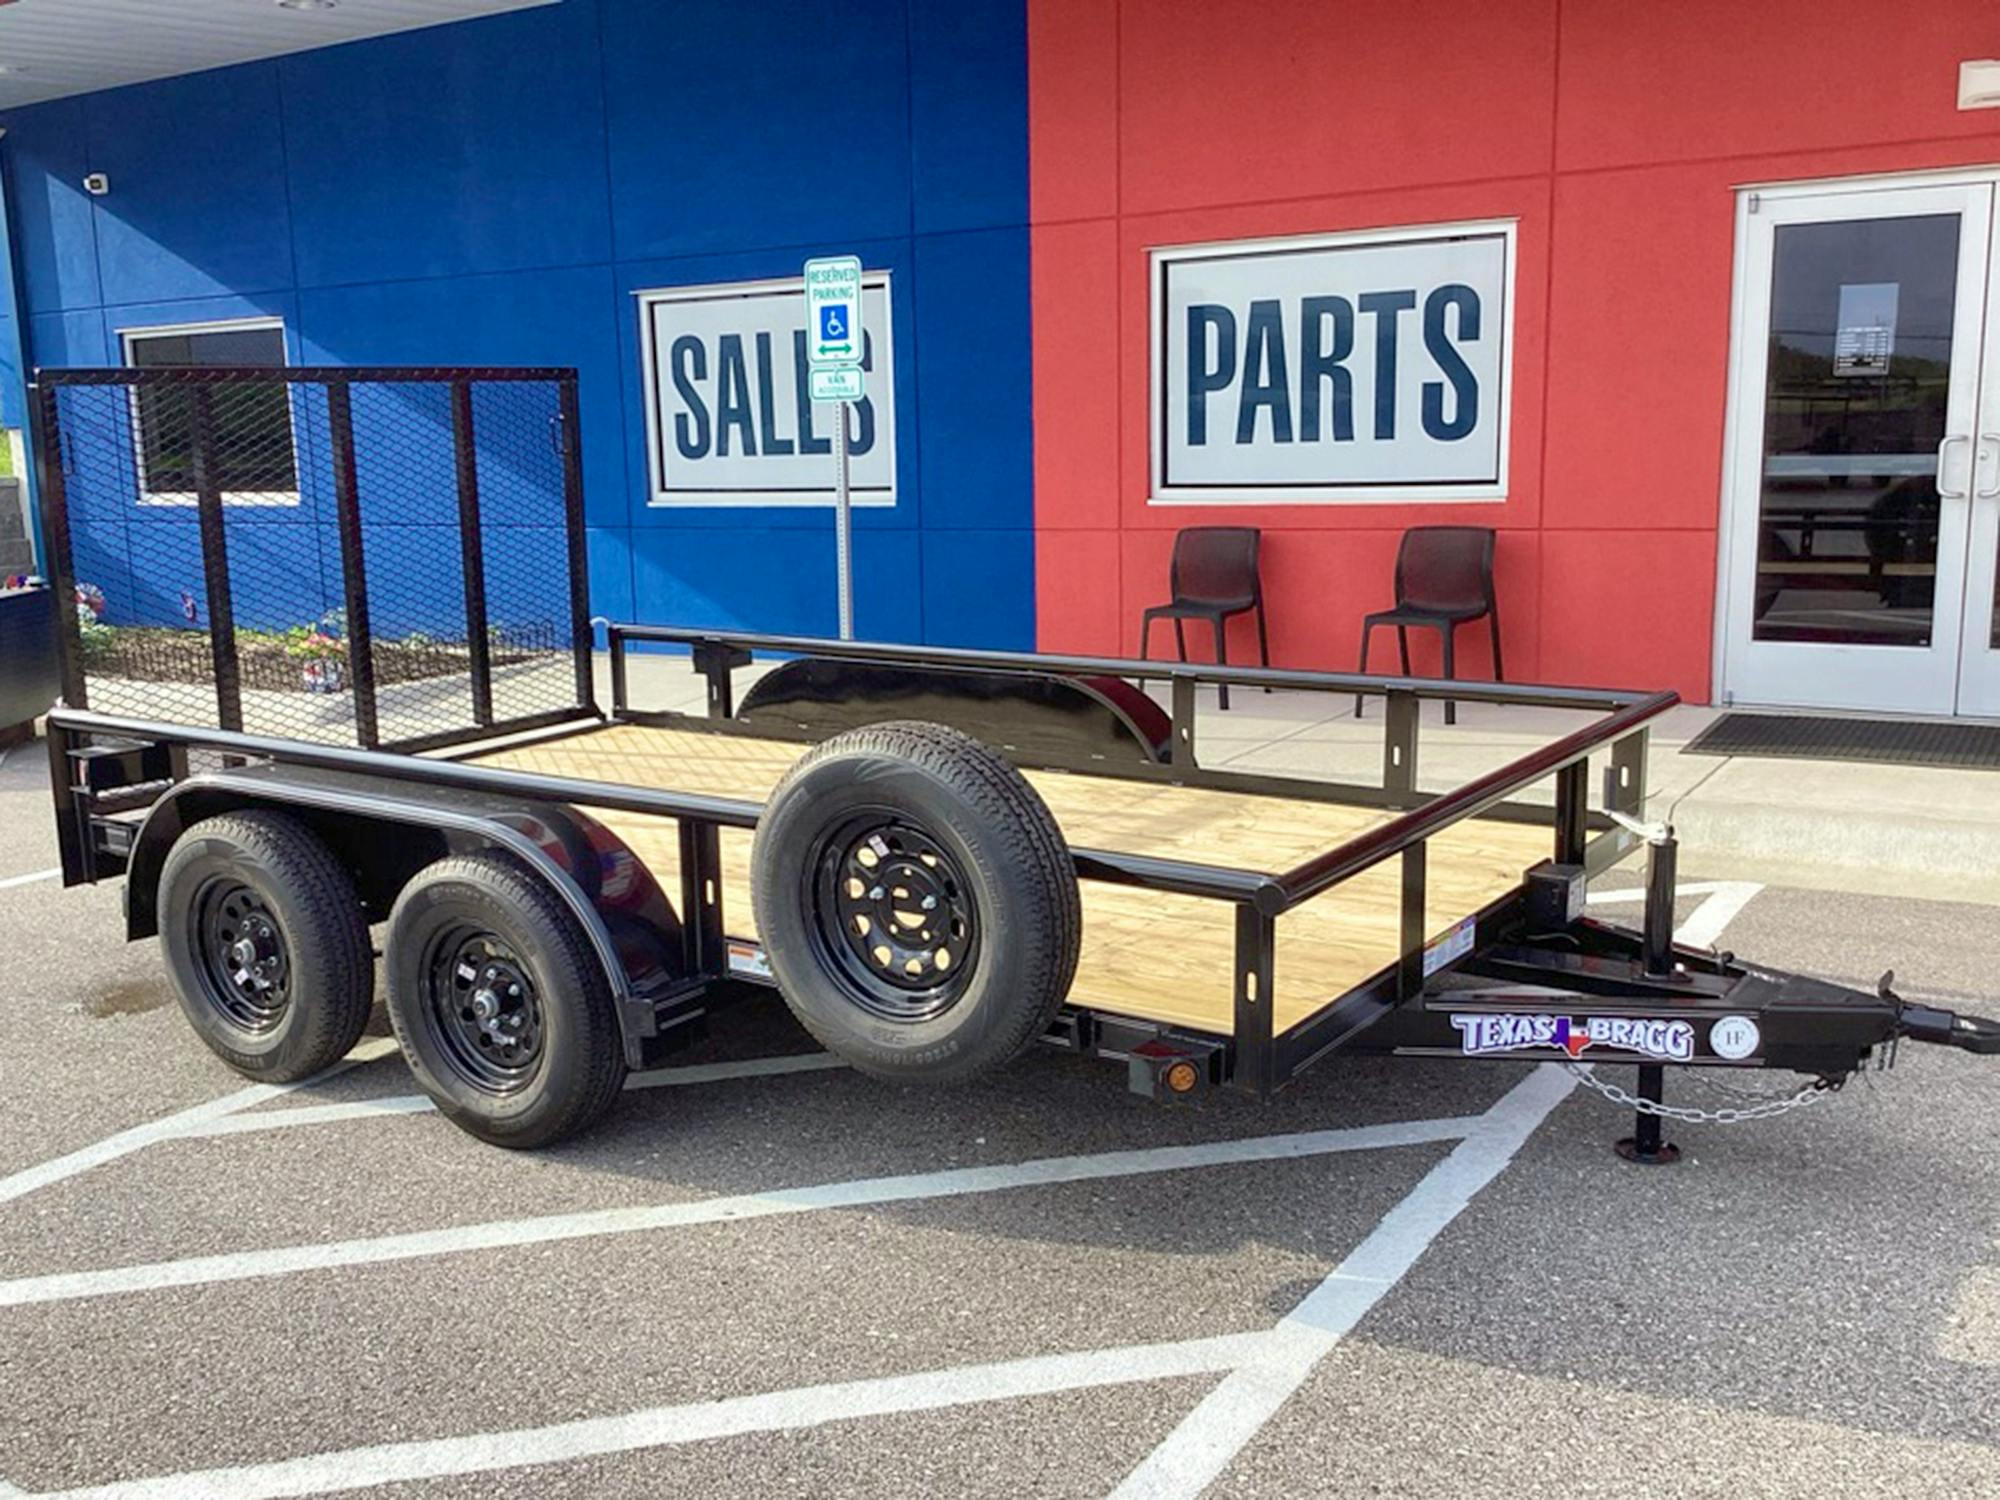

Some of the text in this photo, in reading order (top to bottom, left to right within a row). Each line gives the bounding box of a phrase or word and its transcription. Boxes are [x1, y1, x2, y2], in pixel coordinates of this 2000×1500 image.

[809, 267, 857, 284] RESERVED
[812, 286, 854, 300] PARKING
[1187, 283, 1481, 447] PARTS
[826, 375, 846, 384] VAN
[1452, 1014, 1552, 1053] TEXAS
[1587, 1017, 1694, 1060] BRAGG
